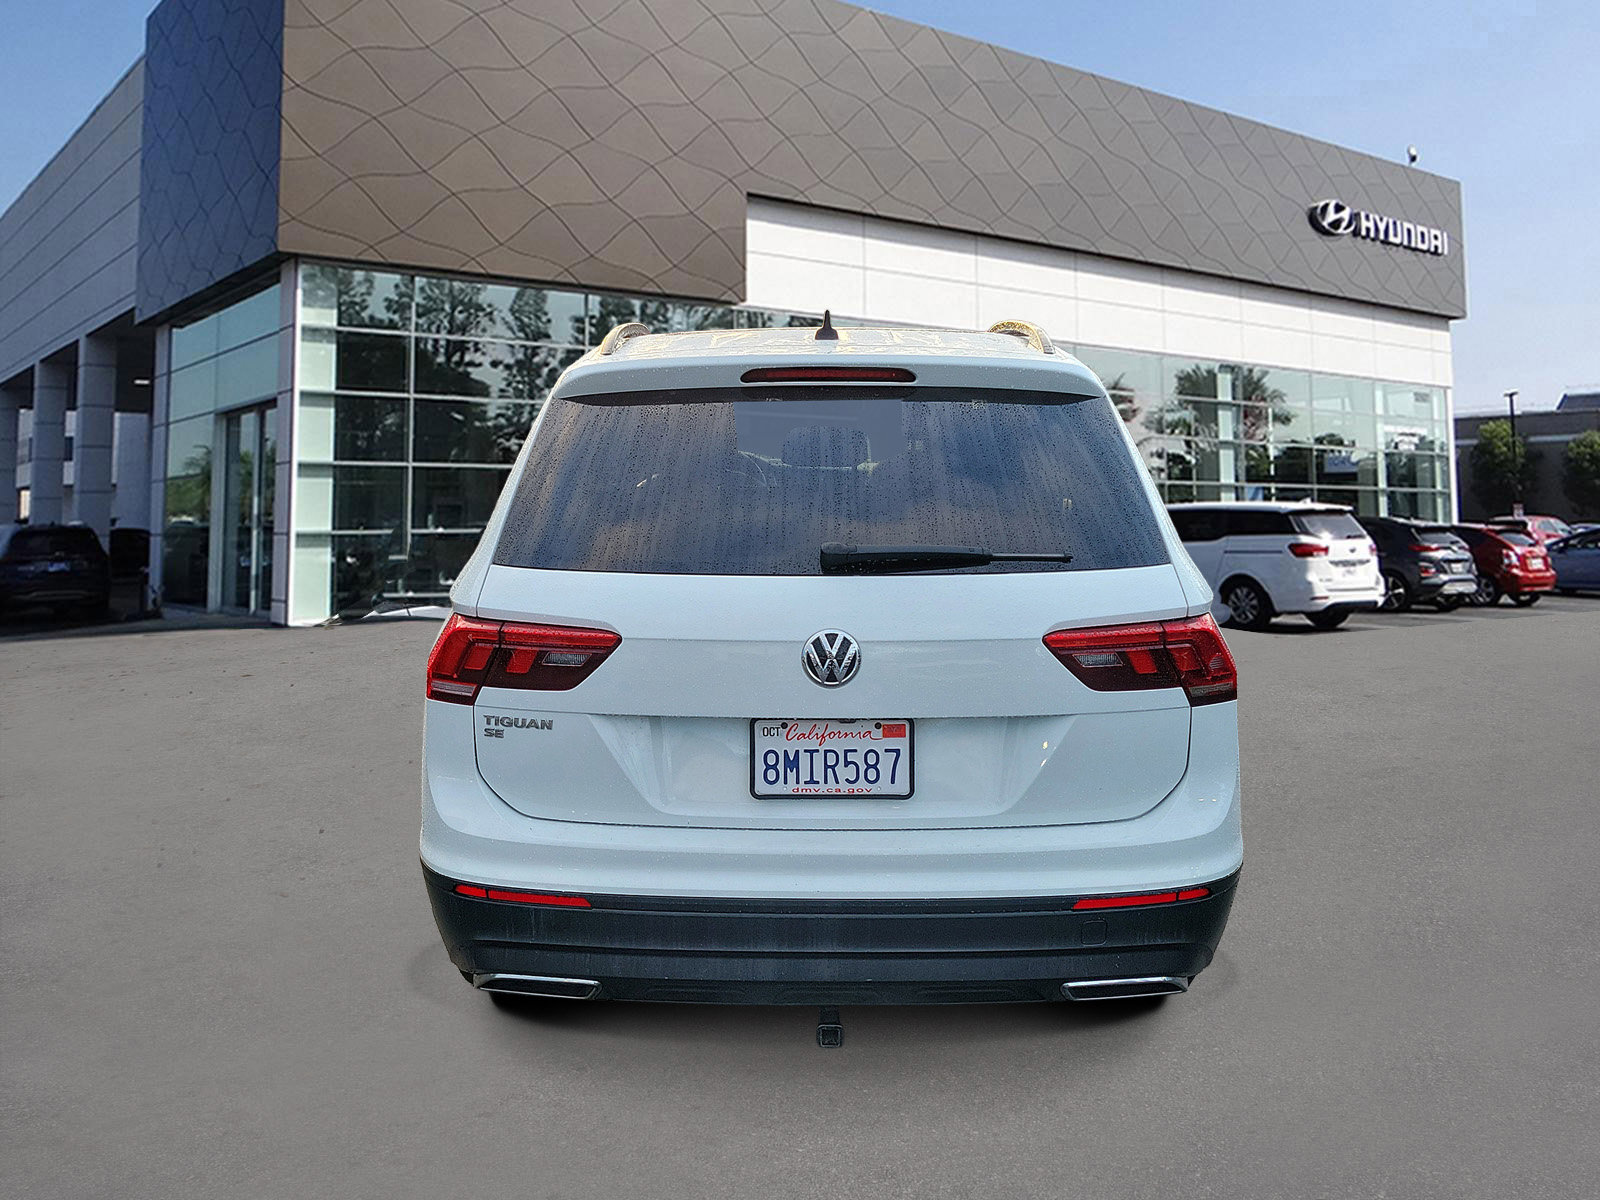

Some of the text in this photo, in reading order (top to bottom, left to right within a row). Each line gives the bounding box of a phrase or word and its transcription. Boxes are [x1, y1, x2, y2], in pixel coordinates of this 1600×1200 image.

[1361, 211, 1449, 255] HYUNDAI
[483, 715, 553, 730] TIGUAN
[763, 727, 781, 737] OCT
[484, 728, 505, 739] SE
[785, 723, 884, 746] California
[763, 749, 901, 785] 8MIR587
